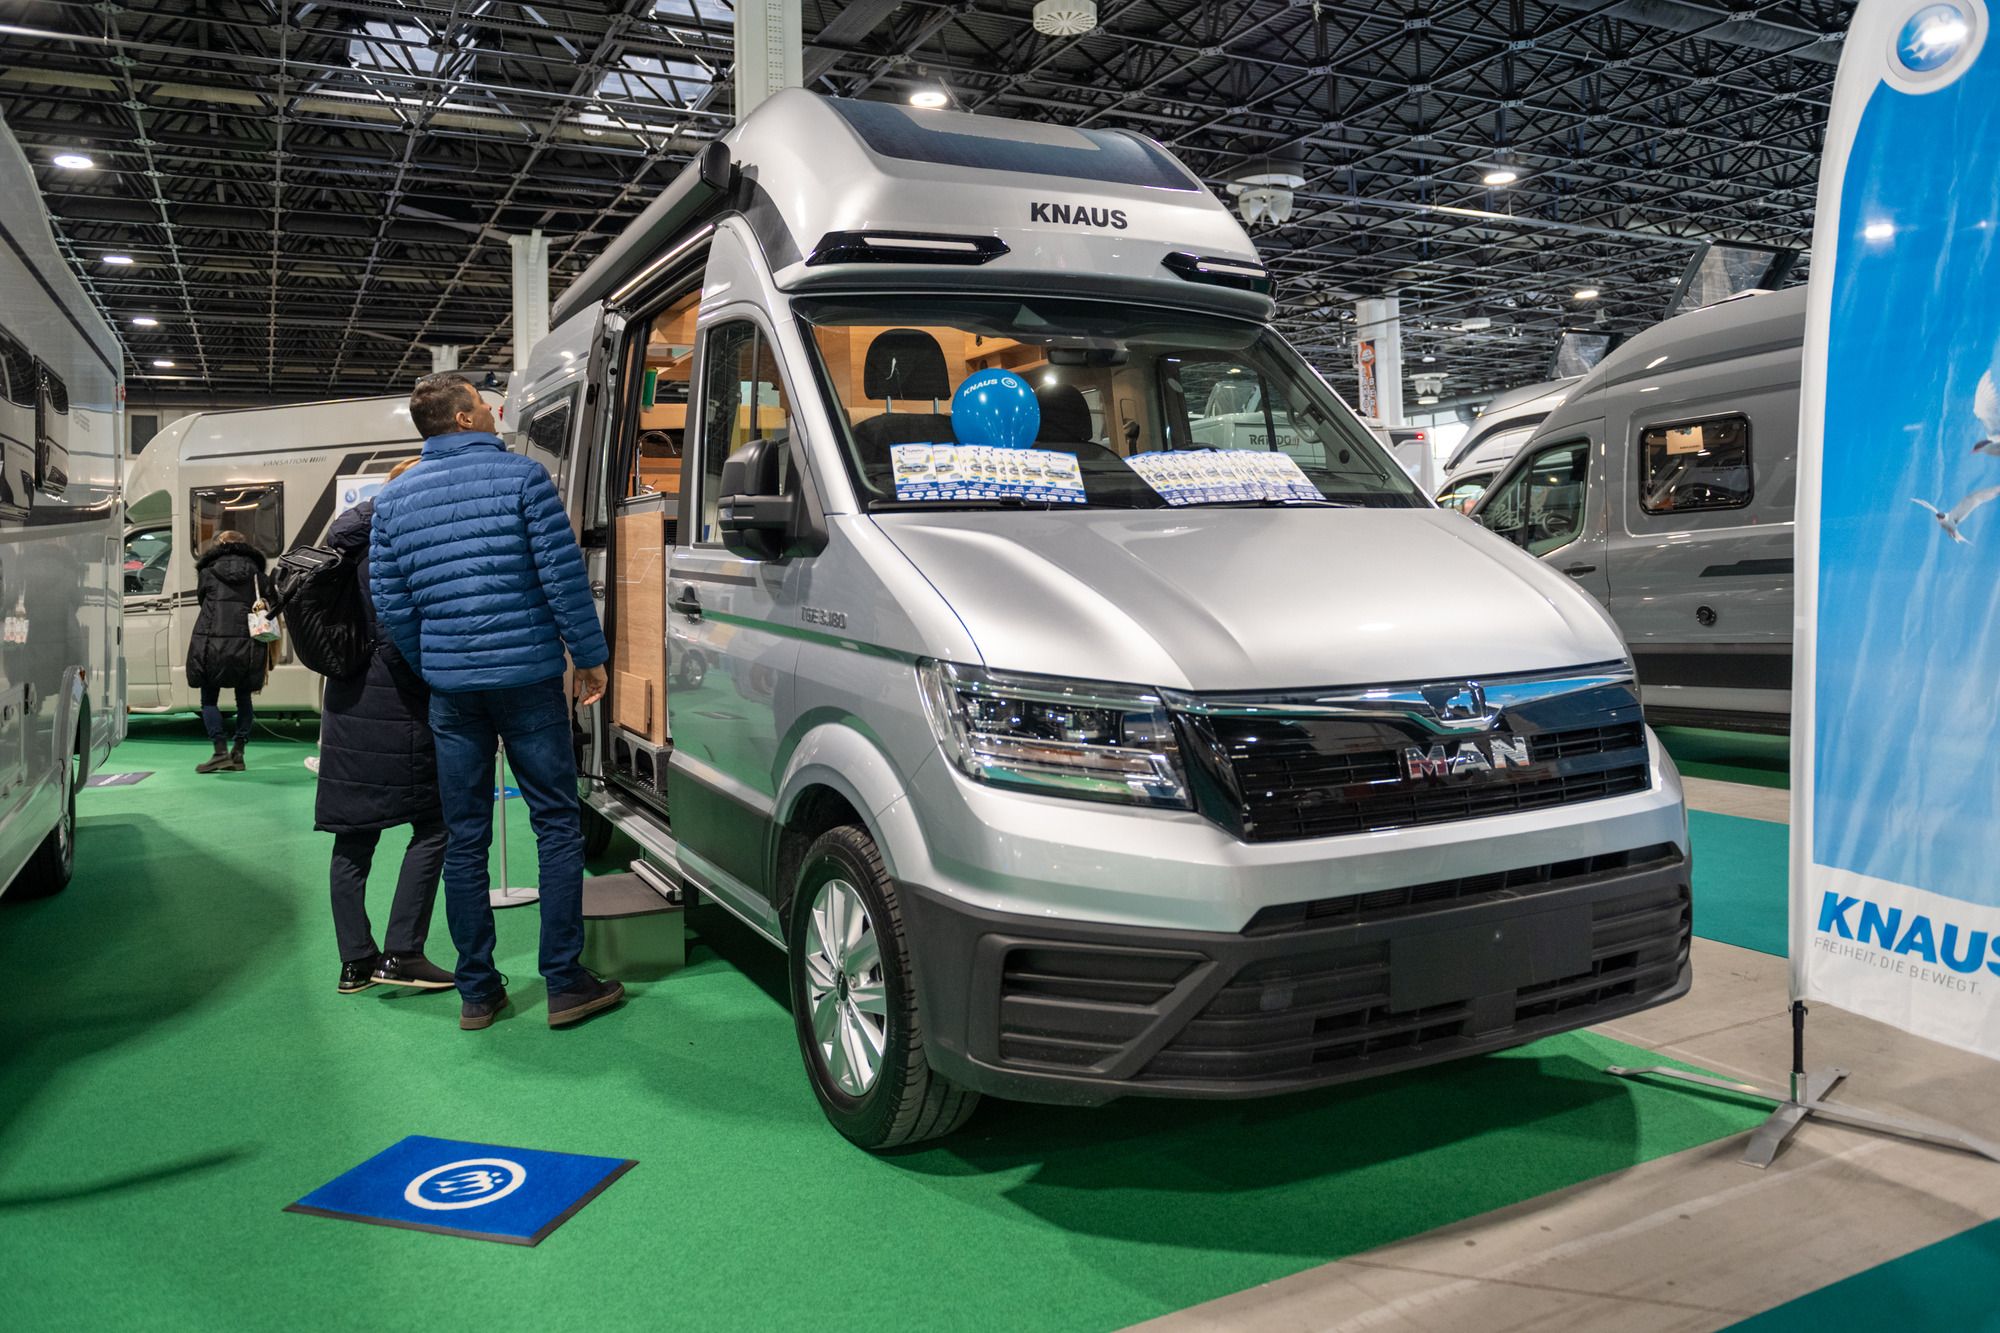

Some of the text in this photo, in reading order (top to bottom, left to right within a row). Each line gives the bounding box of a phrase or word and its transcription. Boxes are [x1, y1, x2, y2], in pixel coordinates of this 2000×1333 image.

[1030, 202, 1128, 229] KNAUS
[963, 378, 998, 397] KNAUS
[1248, 434, 1292, 446] RADO
[263, 457, 308, 467] VANSATION
[1404, 736, 1531, 779] MAN
[1880, 956, 1904, 975] DIE
